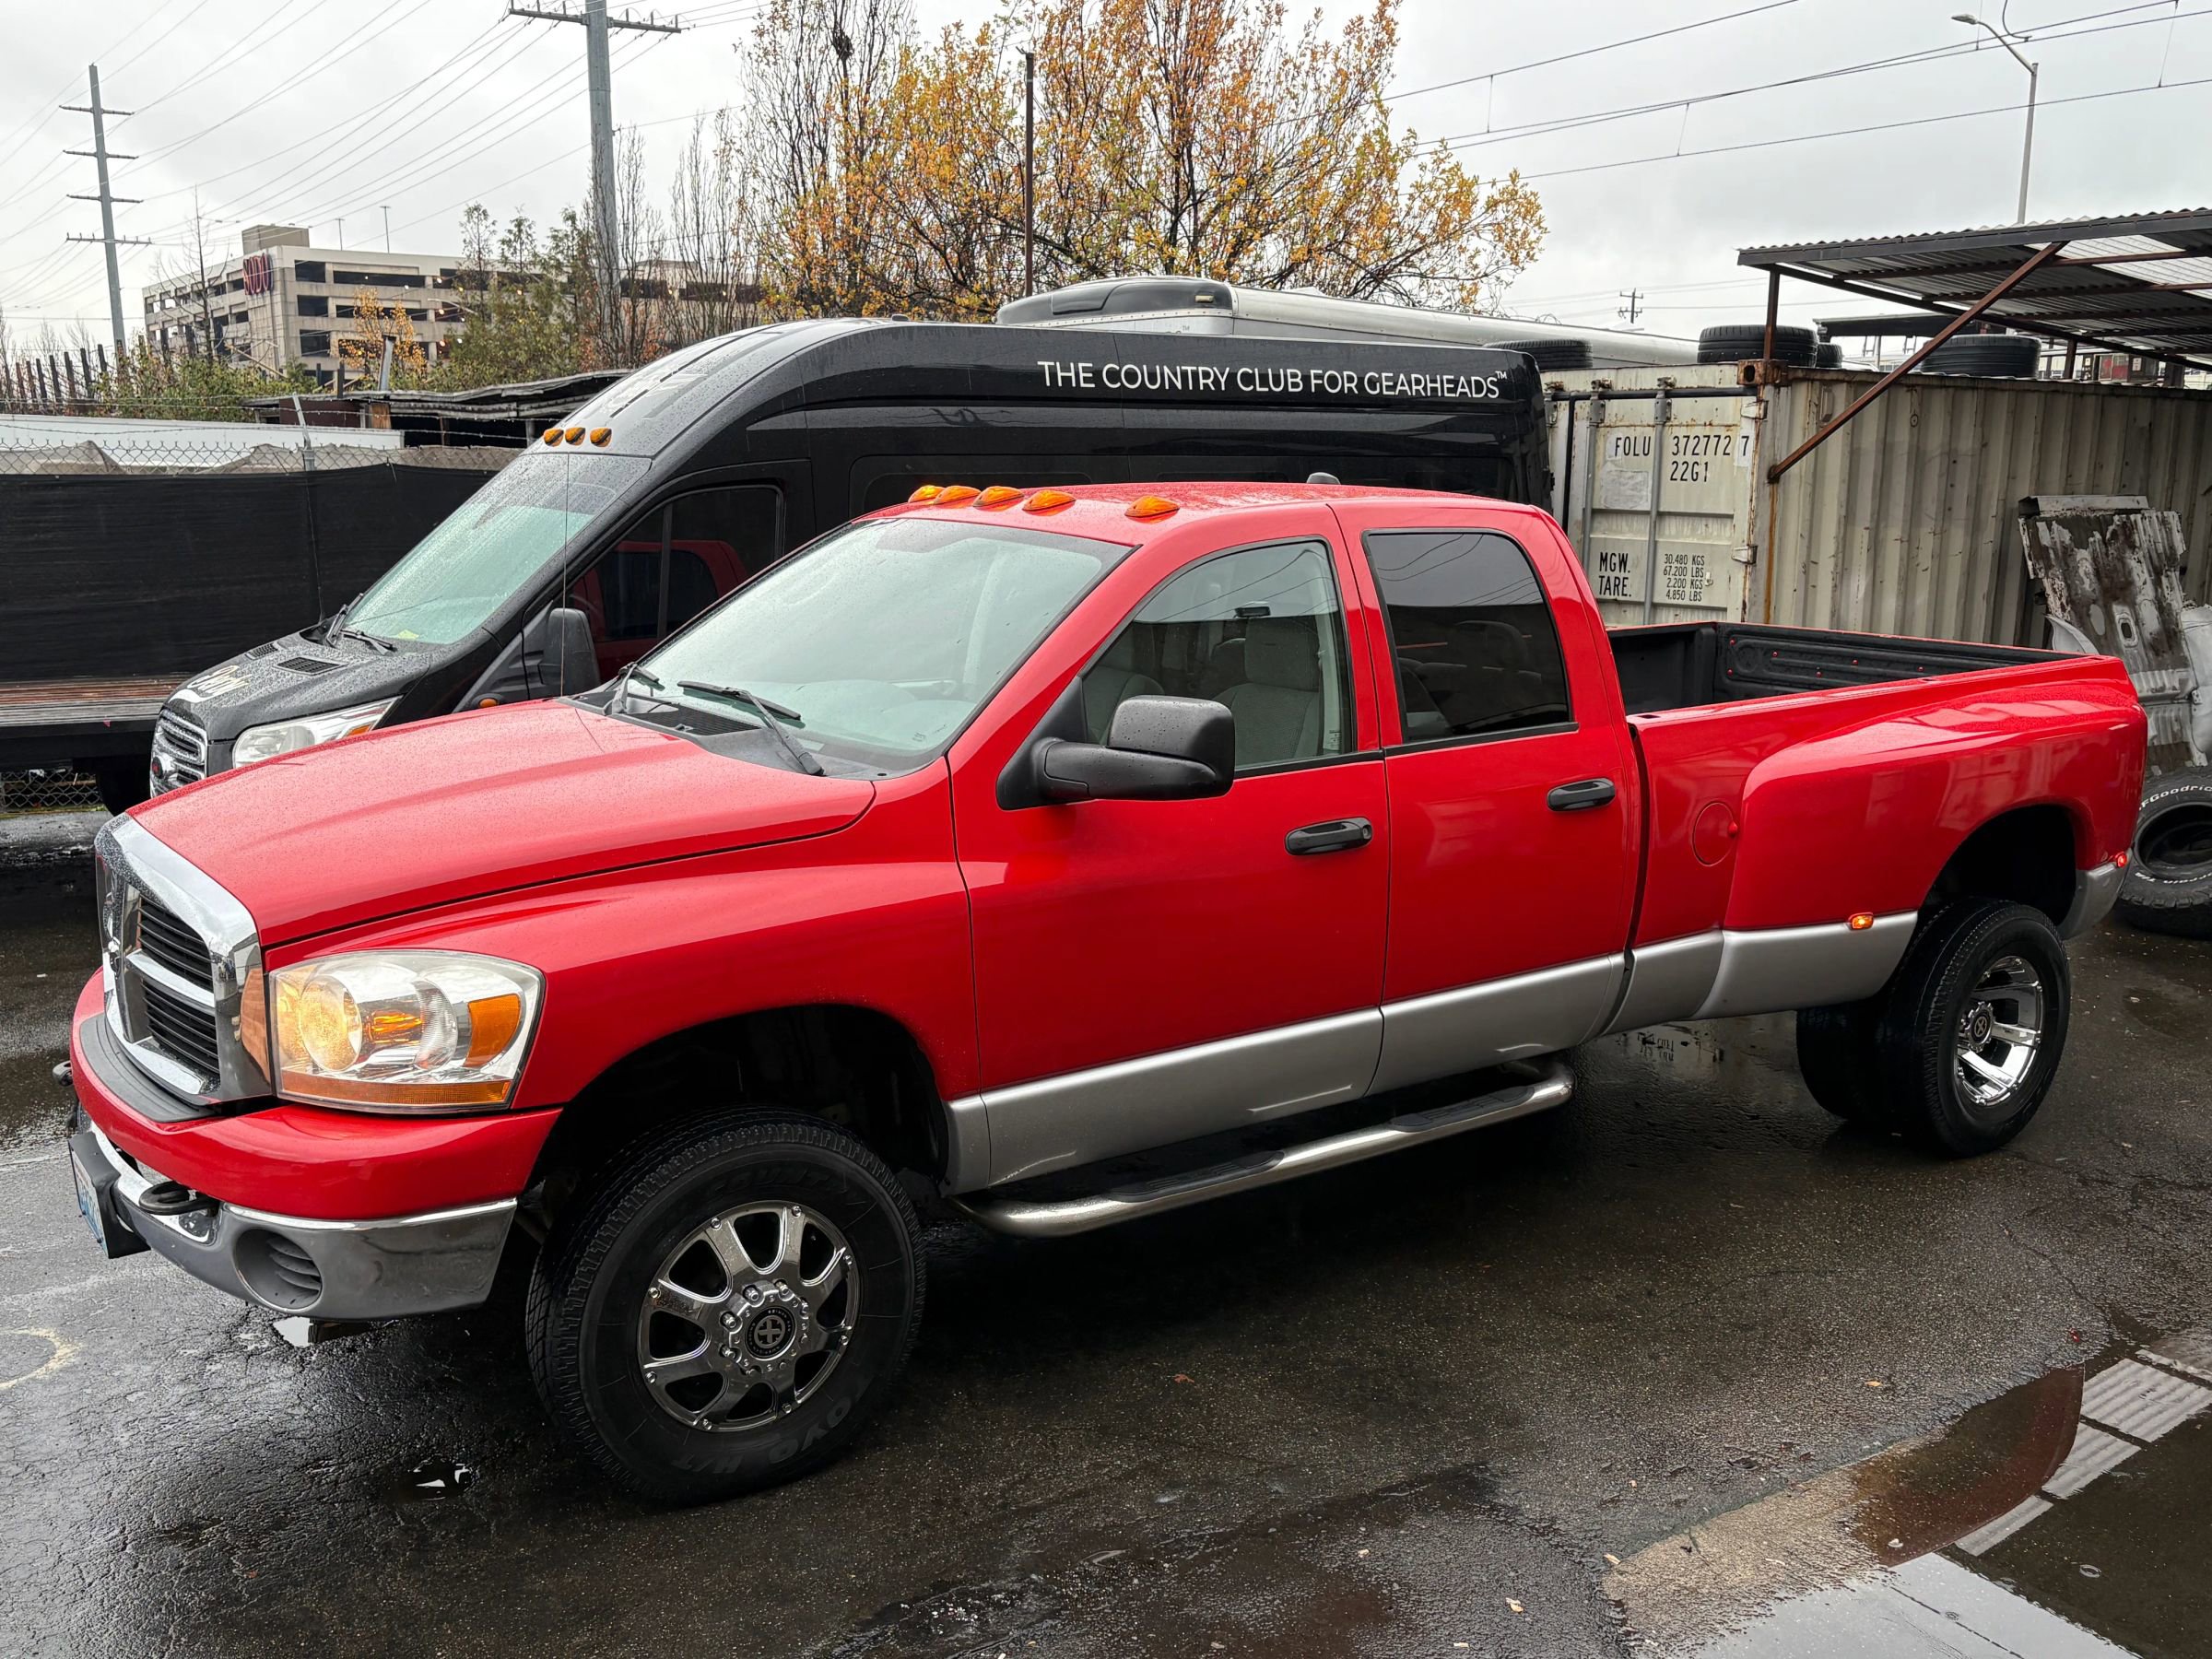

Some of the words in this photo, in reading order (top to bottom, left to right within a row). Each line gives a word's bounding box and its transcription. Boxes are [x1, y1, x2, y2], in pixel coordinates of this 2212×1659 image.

[1037, 360, 1096, 388] THE
[1102, 363, 1230, 392] COUNTRY
[1236, 367, 1303, 393] CLUB
[1310, 370, 1359, 394] FOR
[1614, 435, 1652, 457] FOLU
[1671, 434, 1732, 456] 372772
[1741, 435, 1750, 456] 7
[1669, 460, 1709, 482] 22G1
[1599, 551, 1630, 573] MGW.
[1664, 553, 1688, 565] 30.480
[1691, 554, 1705, 566] KGS
[1663, 565, 1688, 577] 67.200
[1690, 566, 1704, 578] LBS
[1598, 575, 1632, 597] TARE.
[1666, 577, 1687, 589] 2.200
[1689, 578, 1703, 590] KGS
[1665, 589, 1686, 600] 4.850
[1688, 590, 1702, 602] LBS
[2138, 785, 2212, 811] FGoodric
